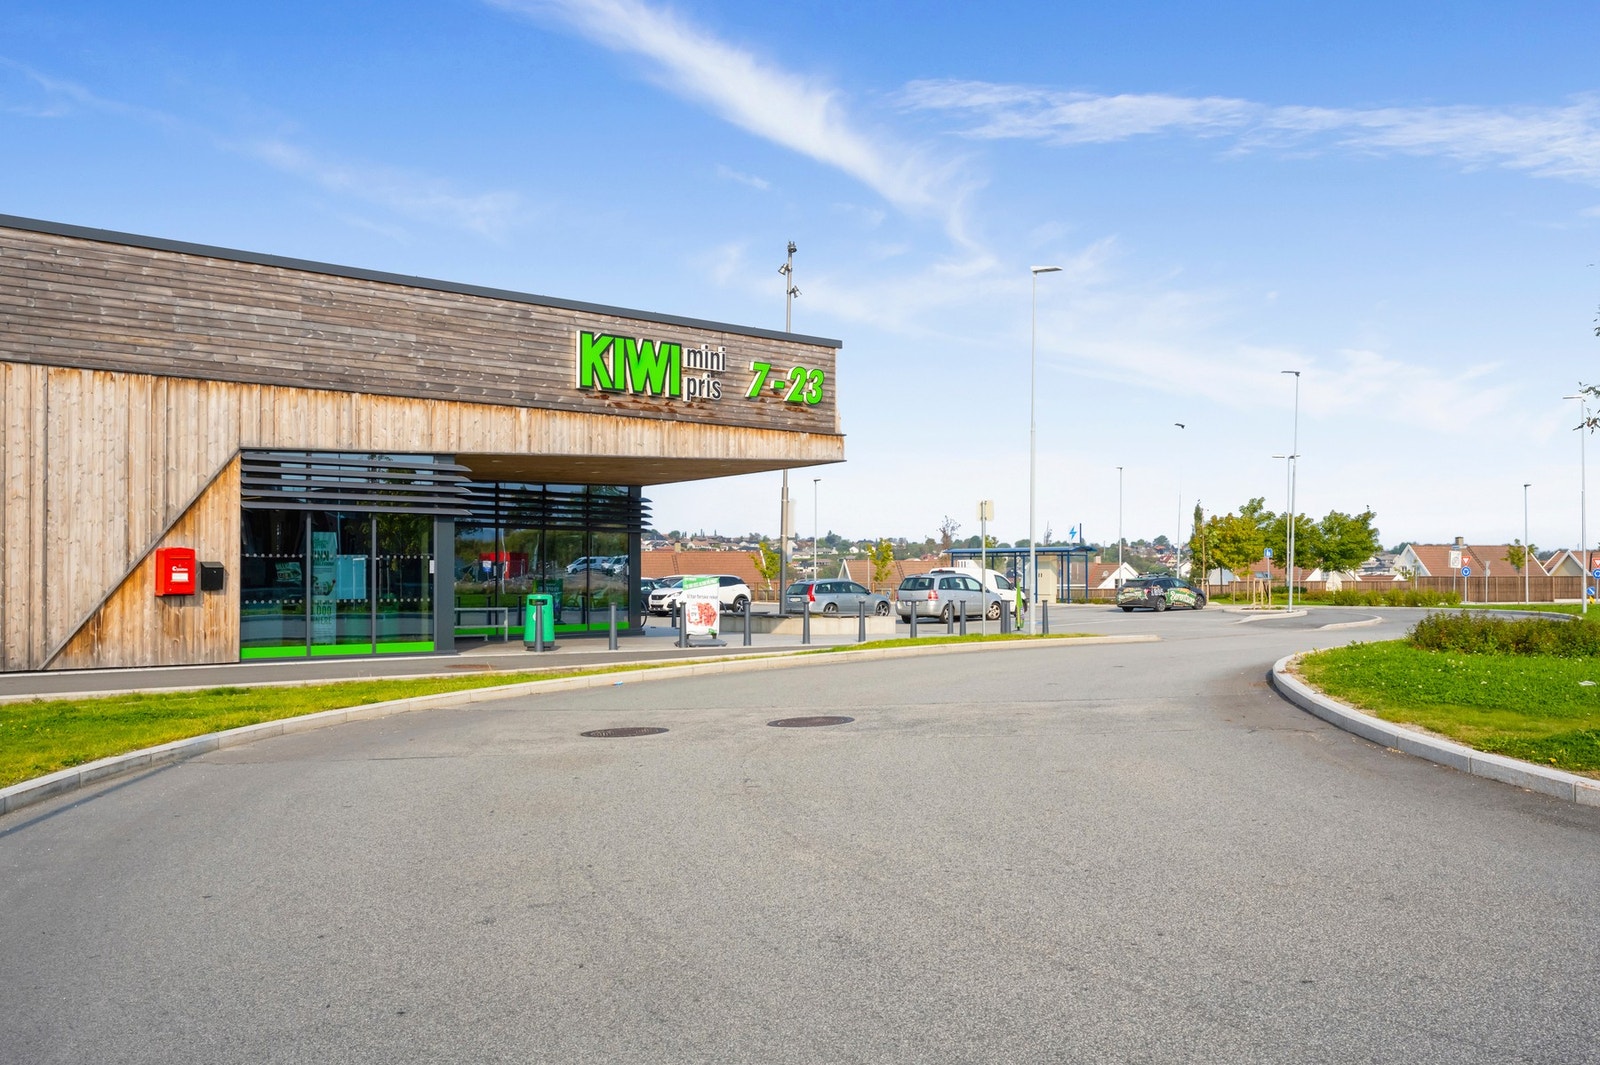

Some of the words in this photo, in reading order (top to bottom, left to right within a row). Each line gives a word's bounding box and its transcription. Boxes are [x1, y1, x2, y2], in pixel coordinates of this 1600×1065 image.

[576, 330, 682, 398] KIWI
[683, 344, 726, 372] mini
[683, 373, 721, 402] pris
